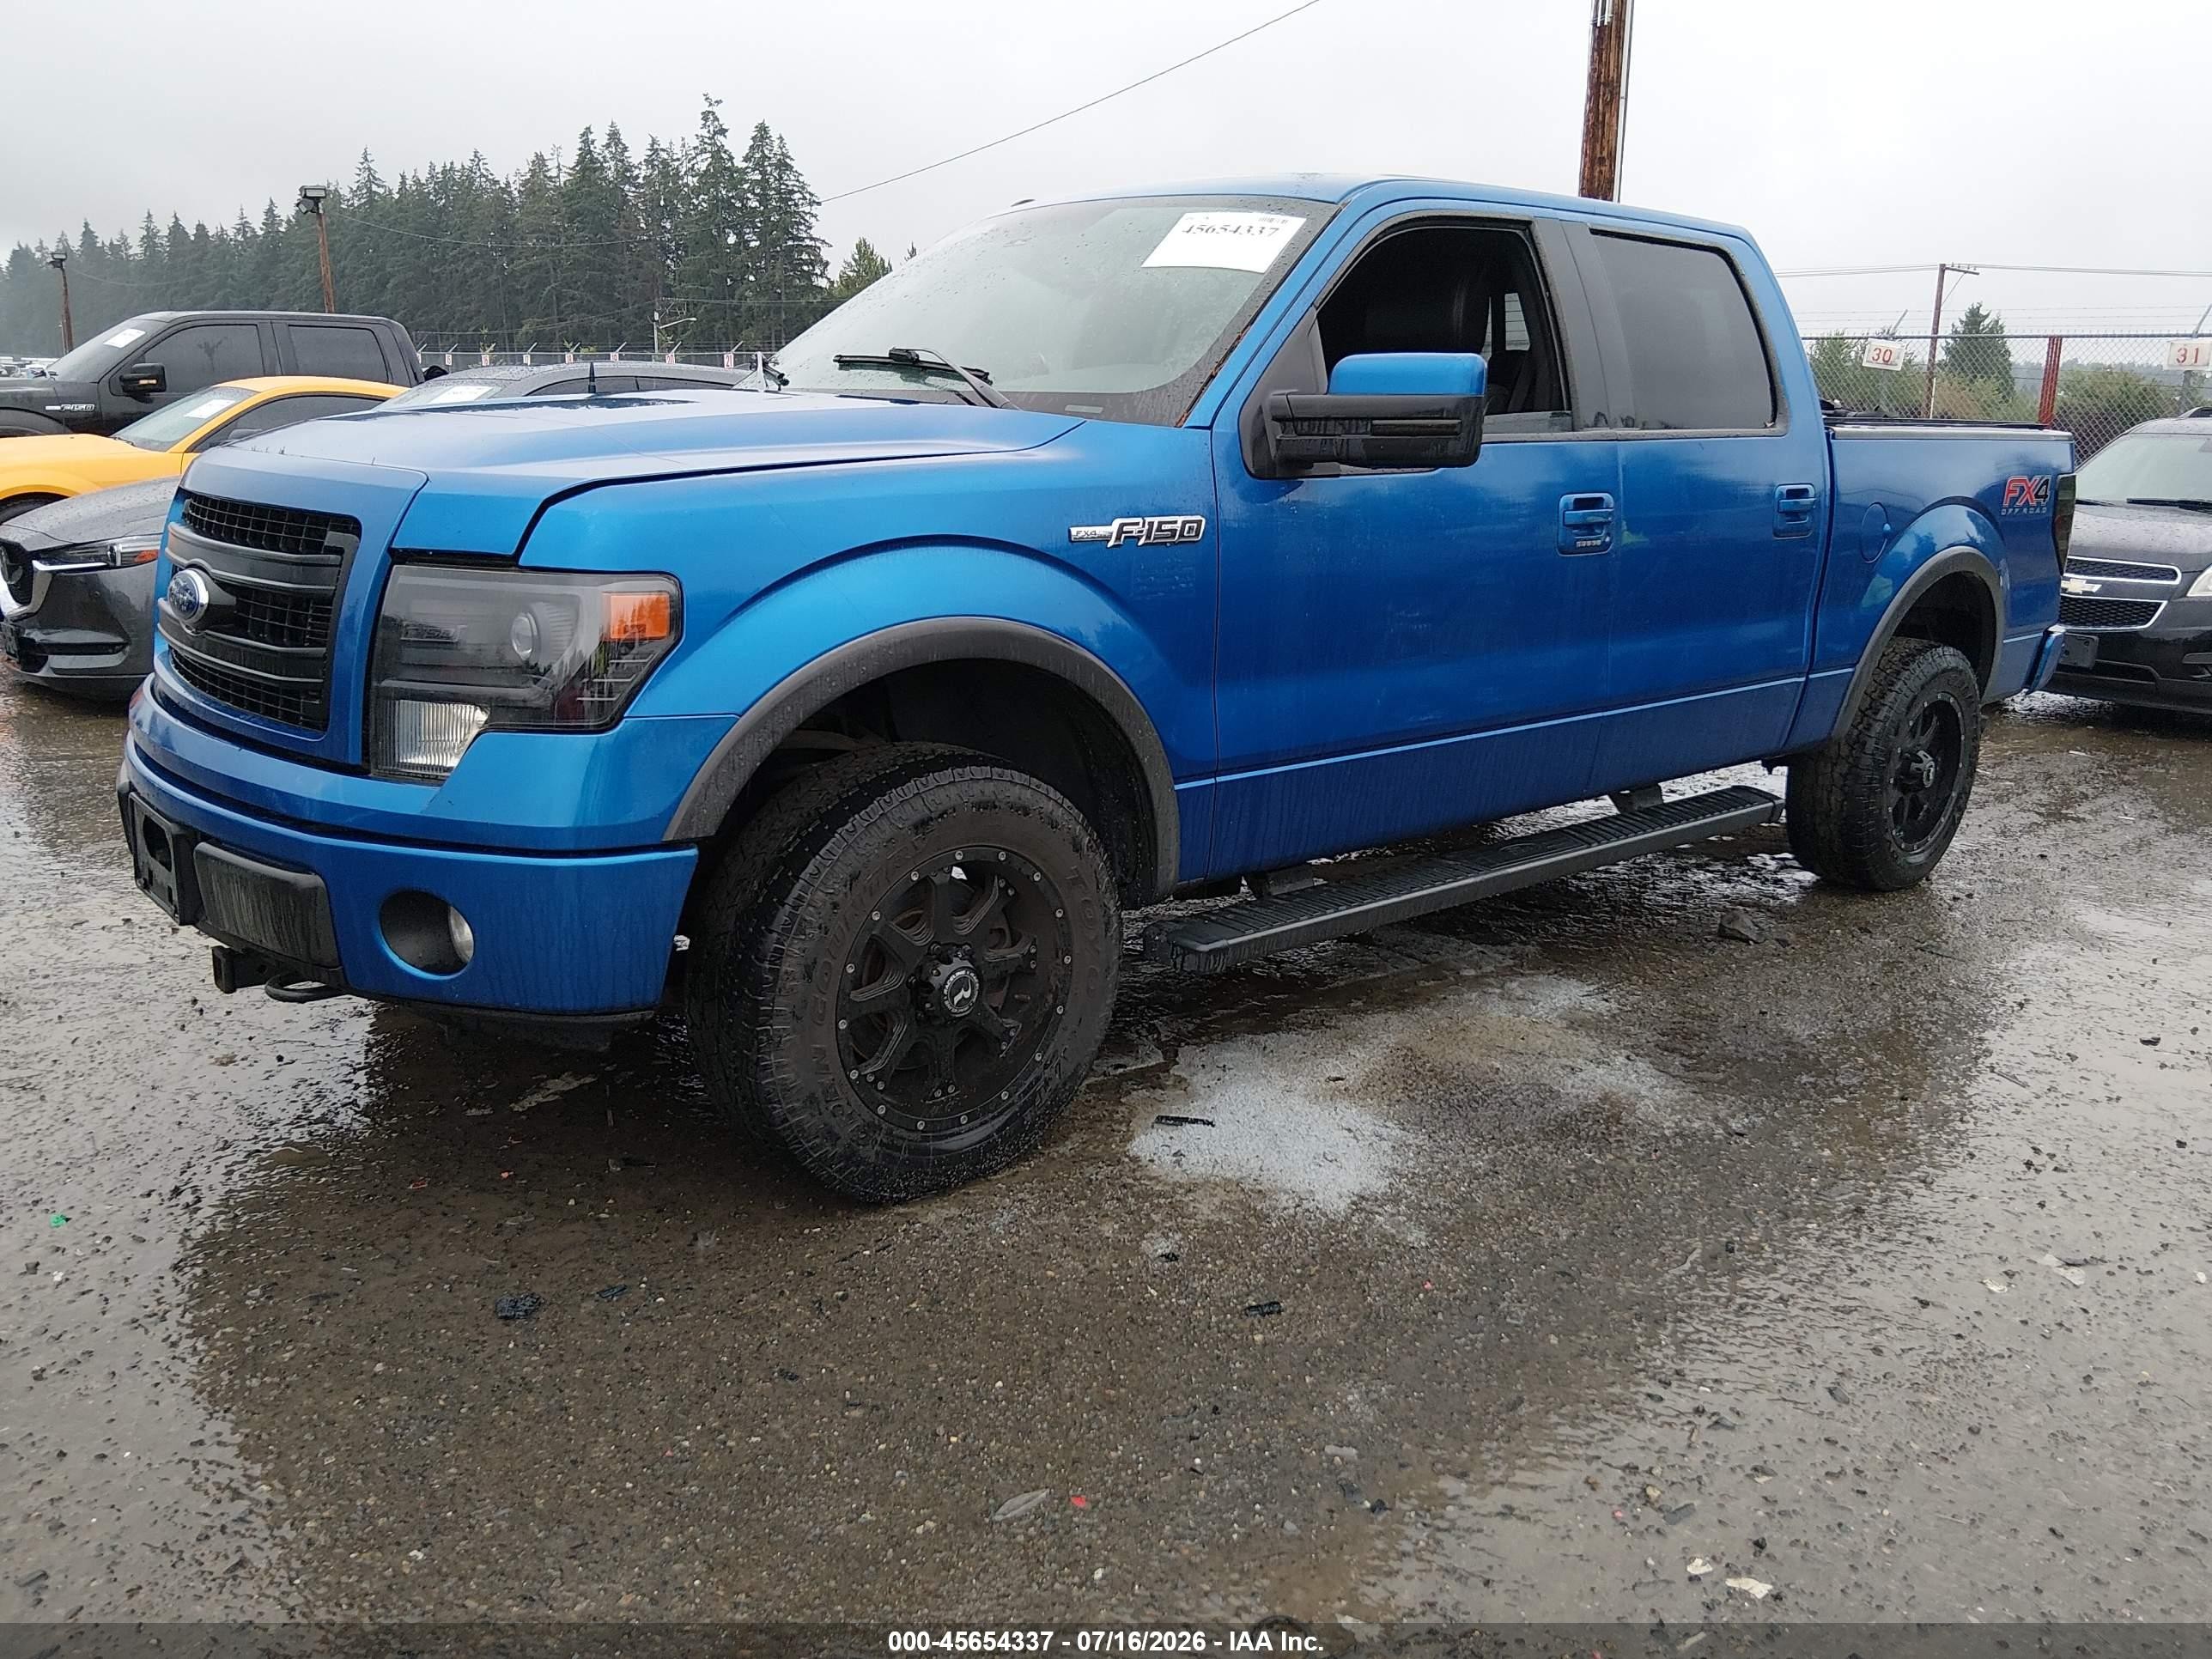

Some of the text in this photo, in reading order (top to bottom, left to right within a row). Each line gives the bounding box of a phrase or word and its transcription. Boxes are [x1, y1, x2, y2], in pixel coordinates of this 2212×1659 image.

[1182, 224, 1279, 236] 45654337
[1872, 347, 1893, 363] 30
[2176, 347, 2199, 364] 31
[2002, 475, 2051, 507] FX4
[2022, 507, 2047, 515] ROAD
[1074, 514, 1206, 548] FX4 F-150
